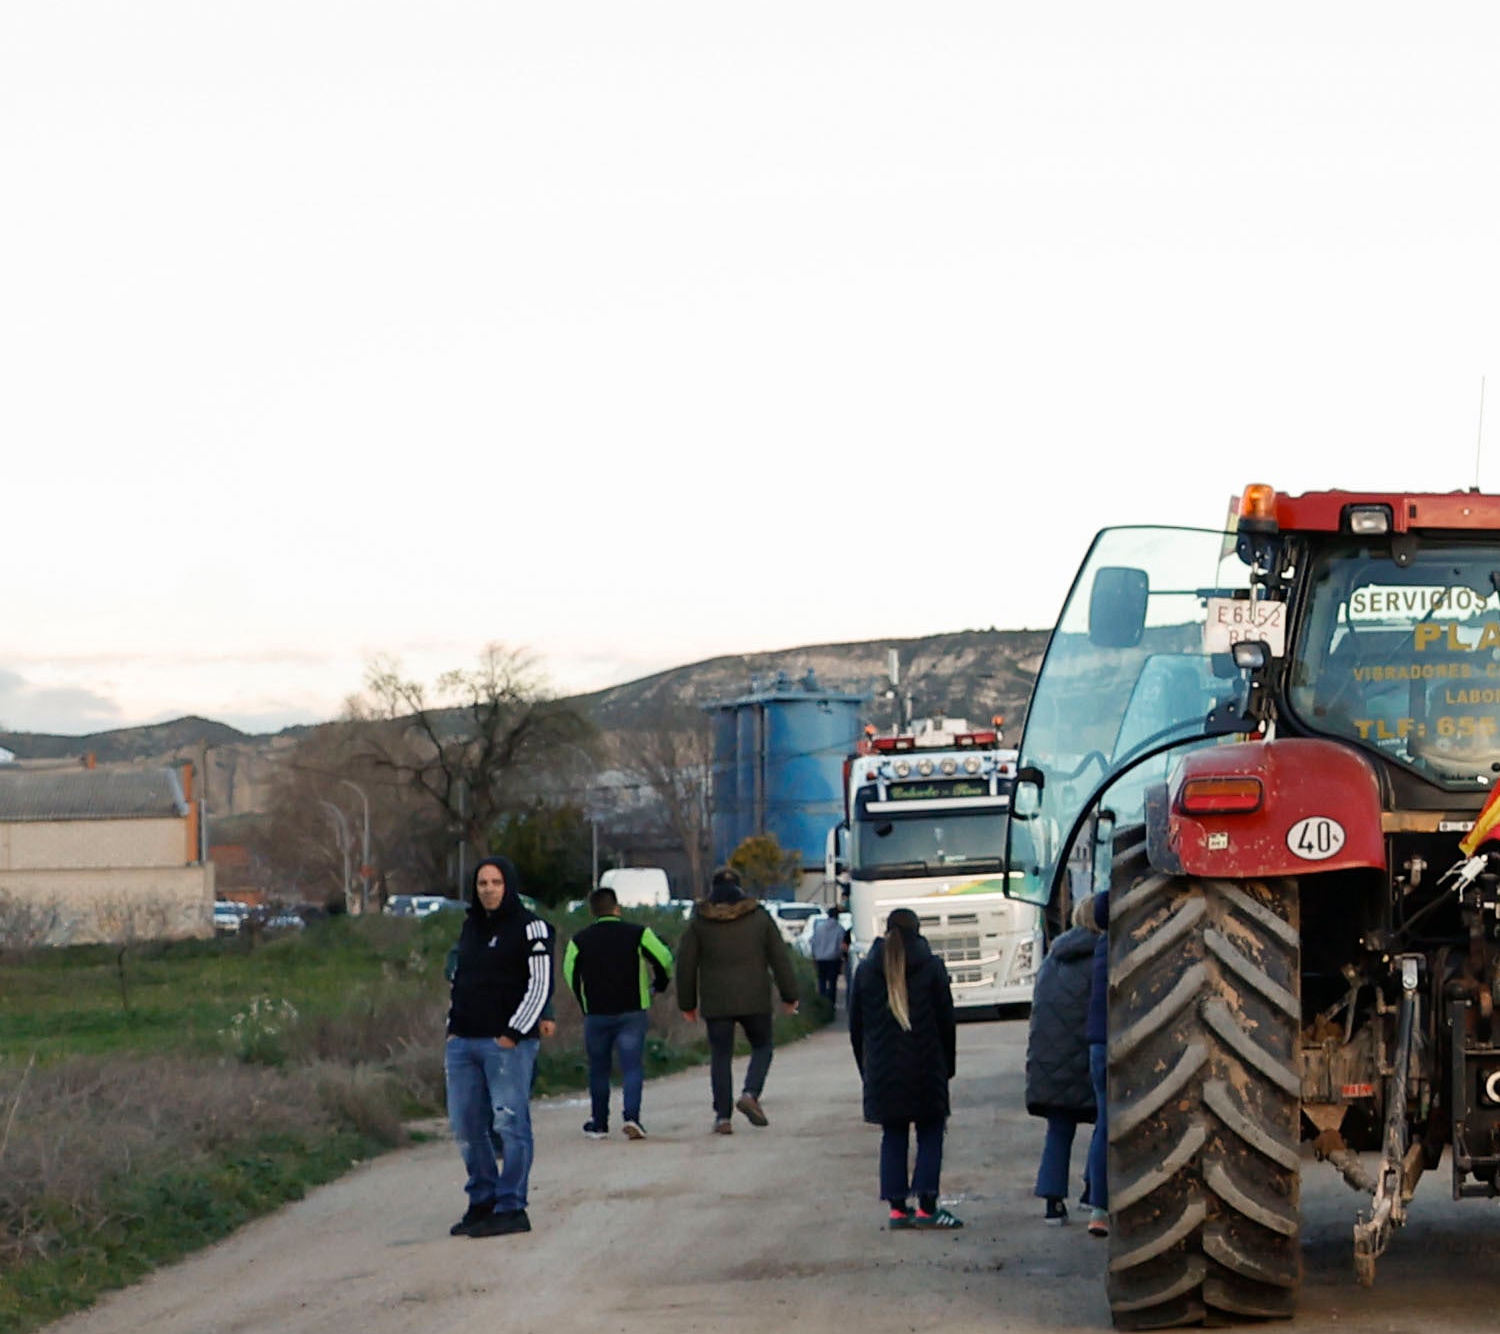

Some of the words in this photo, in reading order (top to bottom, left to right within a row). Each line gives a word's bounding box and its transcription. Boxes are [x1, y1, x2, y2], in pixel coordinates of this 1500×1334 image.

[1353, 589, 1488, 613] SERVICIOS
[1353, 718, 1428, 739] TLF:
[1297, 820, 1331, 854] 40
